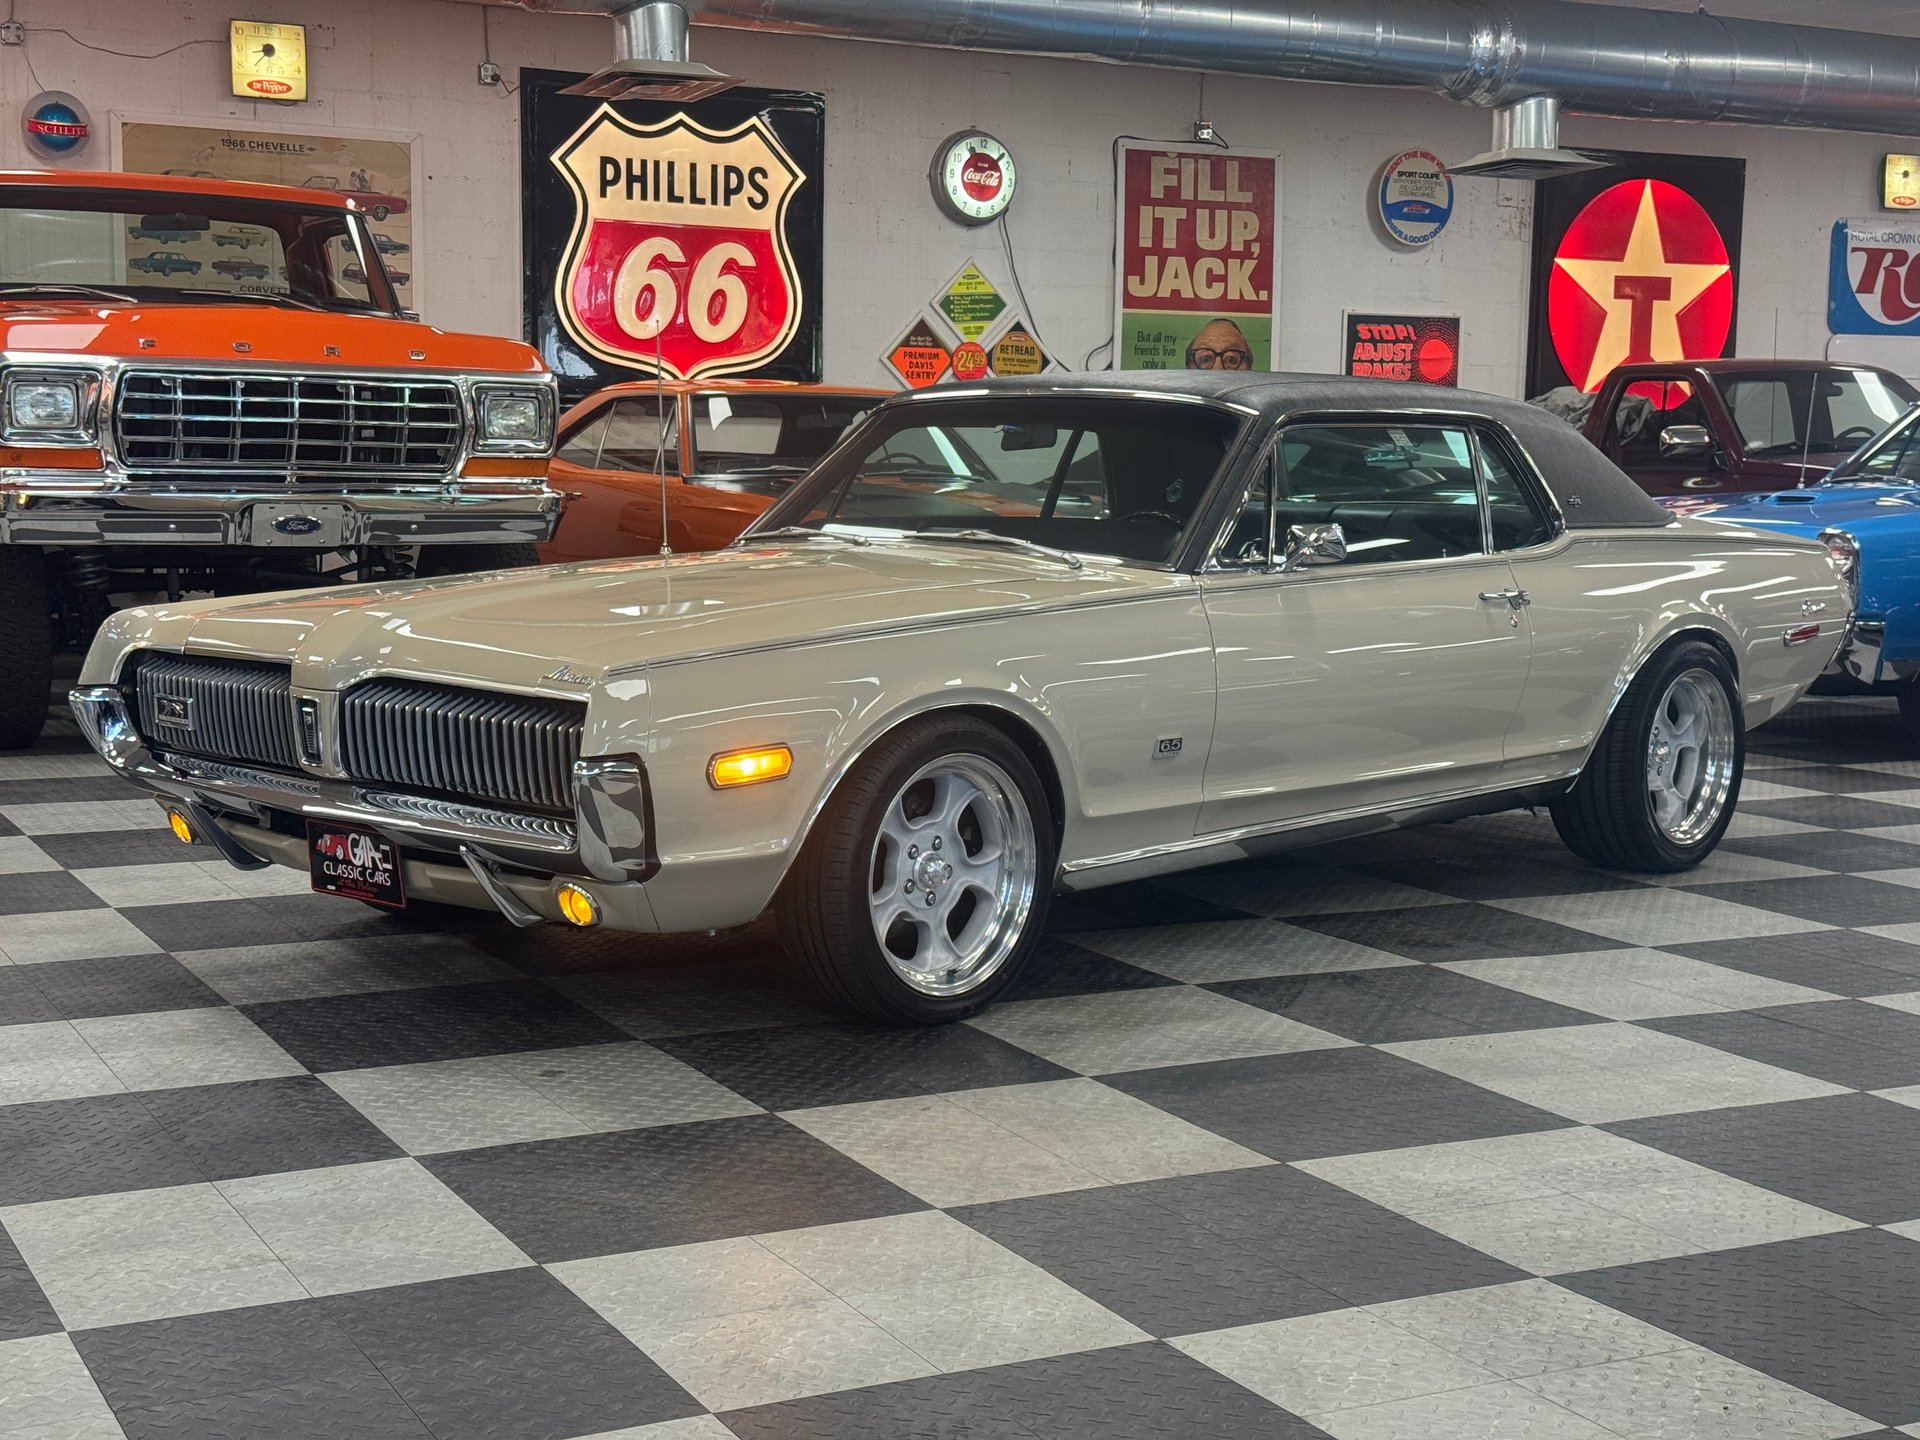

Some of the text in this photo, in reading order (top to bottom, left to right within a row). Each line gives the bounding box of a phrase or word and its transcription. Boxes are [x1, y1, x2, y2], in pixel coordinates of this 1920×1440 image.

[235, 27, 244, 36] 10
[254, 26, 260, 35] 11
[294, 32, 301, 41] 2
[252, 81, 289, 94] Dr Pepper
[220, 138, 305, 152] 1966 CHEVELLE
[980, 139, 988, 149] 12
[953, 153, 963, 163] 10
[1403, 151, 1418, 161] THE
[1420, 151, 1437, 163] NEW
[1005, 161, 1011, 171] 2
[950, 169, 955, 179] 9
[963, 168, 1001, 187] Coca-Cola
[1397, 171, 1440, 181] SPORT COUPE
[600, 156, 769, 210] PHILLIPS
[1007, 178, 1013, 188] 3
[1150, 156, 1253, 204] FILL
[952, 186, 958, 196] 8
[1001, 194, 1007, 203] 4
[961, 201, 968, 211] 7
[990, 205, 996, 214] 5
[976, 207, 981, 217] 6
[1138, 205, 1260, 258] IT UP,
[1409, 235, 1430, 244] GOOD
[1881, 232, 1916, 245] CROWN
[1127, 255, 1269, 301] JACK.
[613, 236, 758, 344] 66
[1613, 275, 1672, 365] T
[1356, 323, 1417, 341] STOP!
[1137, 331, 1177, 346] But all my
[903, 351, 939, 360] PREMIUM
[1000, 345, 1035, 356] RETREAD
[1134, 344, 1177, 357] friends live
[1352, 342, 1413, 361] ADJUST
[909, 361, 934, 370] DAVIS
[1161, 361, 1167, 369] a
[905, 370, 937, 379] SENTRY
[1352, 362, 1411, 380] BRAKES
[286, 520, 310, 531] Ford
[1160, 739, 1181, 752] 6.5
[323, 861, 392, 887] CLASSIC CARS
